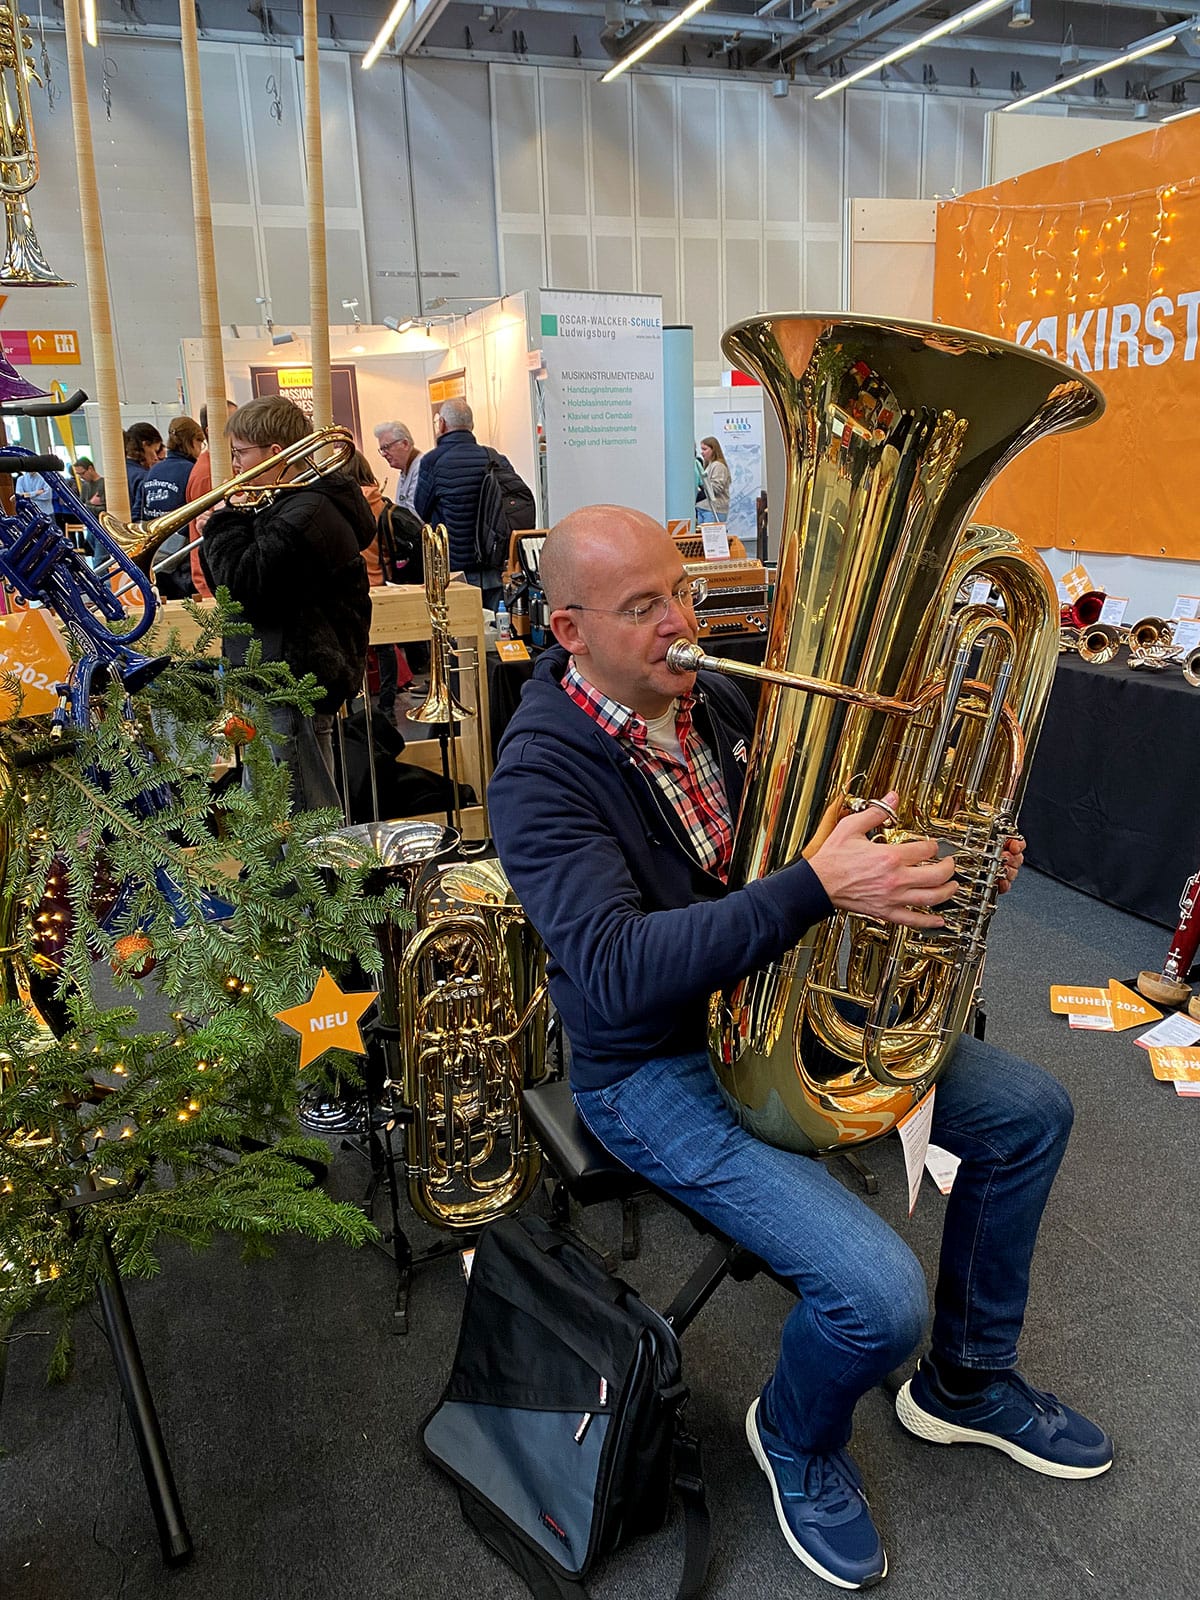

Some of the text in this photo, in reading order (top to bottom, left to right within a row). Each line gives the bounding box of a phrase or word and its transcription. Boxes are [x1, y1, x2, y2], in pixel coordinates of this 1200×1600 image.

[559, 314, 660, 328] OSCAR-WALCKER-SCHULE
[560, 327, 616, 340] Ludwigsburg
[1065, 291, 1200, 373] KIRST
[561, 371, 655, 381] MUSIKINSTRUMENTENBAU
[567, 385, 633, 395] Handzuginstrumente
[567, 399, 632, 407] Holzblasinstrumente
[567, 411, 633, 420] Klavier und Cembalo
[568, 424, 637, 433] Metallblasinstrumente
[569, 438, 638, 447] Orgel und Harmonium
[143, 479, 179, 493] usikverein
[1057, 995, 1147, 1015] NEUHEIT 2024
[309, 1010, 349, 1033] NEU
